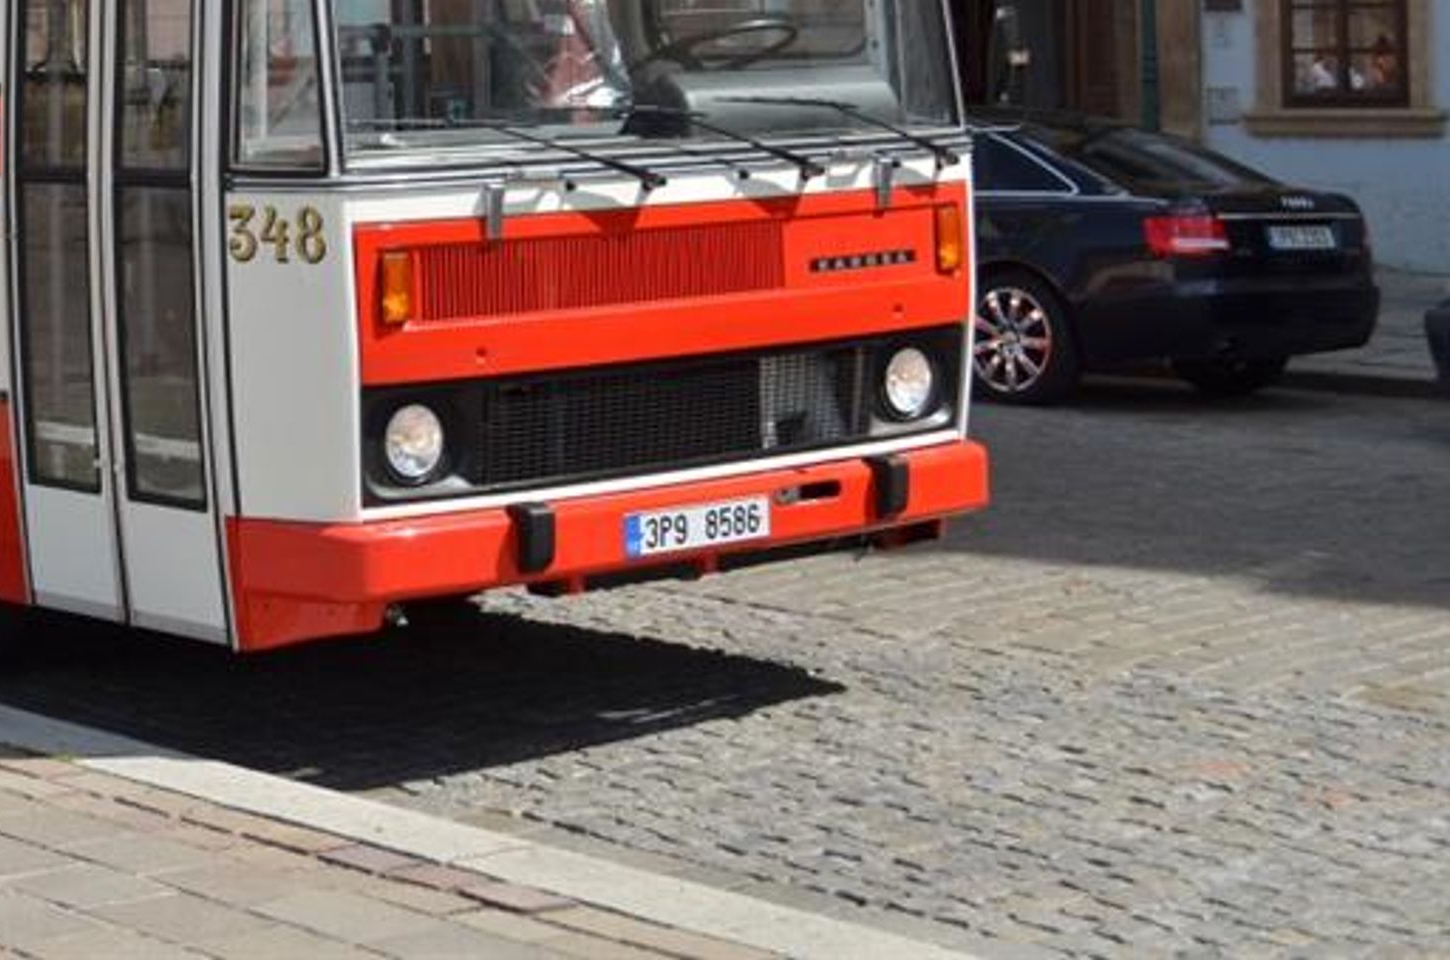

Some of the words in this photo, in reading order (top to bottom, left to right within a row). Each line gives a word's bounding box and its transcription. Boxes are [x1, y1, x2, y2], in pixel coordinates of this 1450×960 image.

[229, 204, 327, 265] 348
[645, 513, 688, 548] 3P9
[705, 504, 760, 539] 8586
